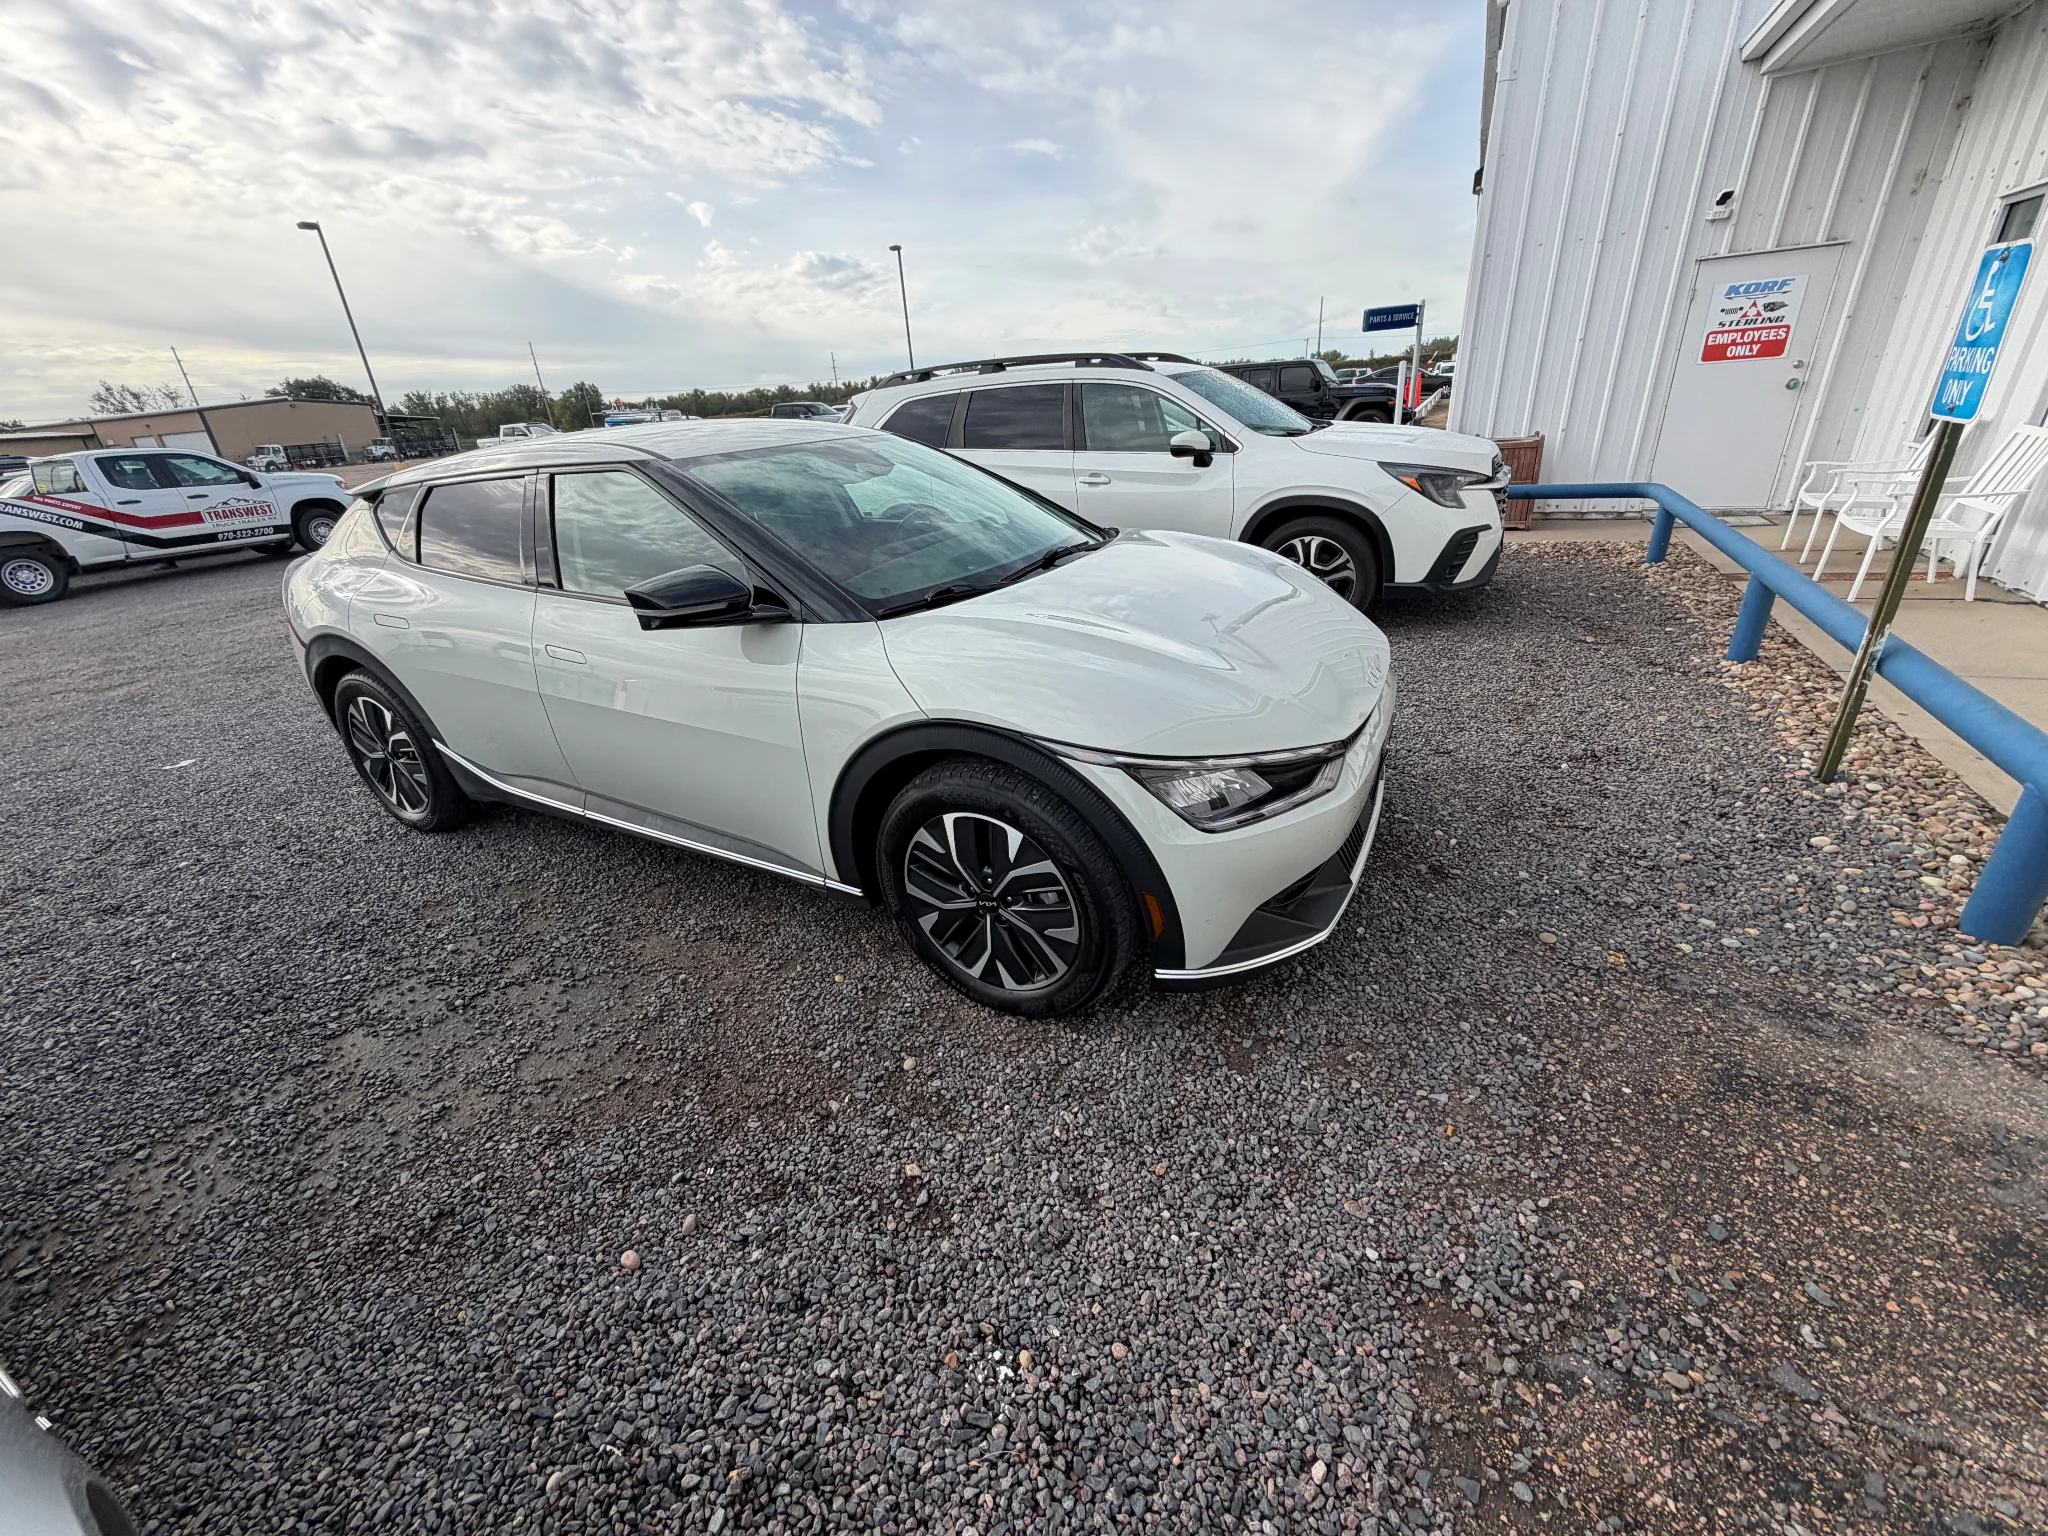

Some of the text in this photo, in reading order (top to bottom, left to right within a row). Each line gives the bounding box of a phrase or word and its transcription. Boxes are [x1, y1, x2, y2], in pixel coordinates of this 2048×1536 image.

[1724, 278, 1796, 297] KORF
[1369, 315, 1388, 323] PARTS
[1392, 312, 1415, 321] SERVICE
[1718, 315, 1785, 328] STERLING
[1707, 327, 1787, 345] EMPLOYEES
[1726, 344, 1761, 357] ONLY
[1946, 346, 1995, 374] PARKING
[1942, 379, 1974, 405] ONLY
[206, 504, 274, 521] TRANSWEST
[212, 521, 237, 529] TRUCK
[237, 517, 267, 525] TRAILER
[217, 527, 274, 541] 970-522-2700
